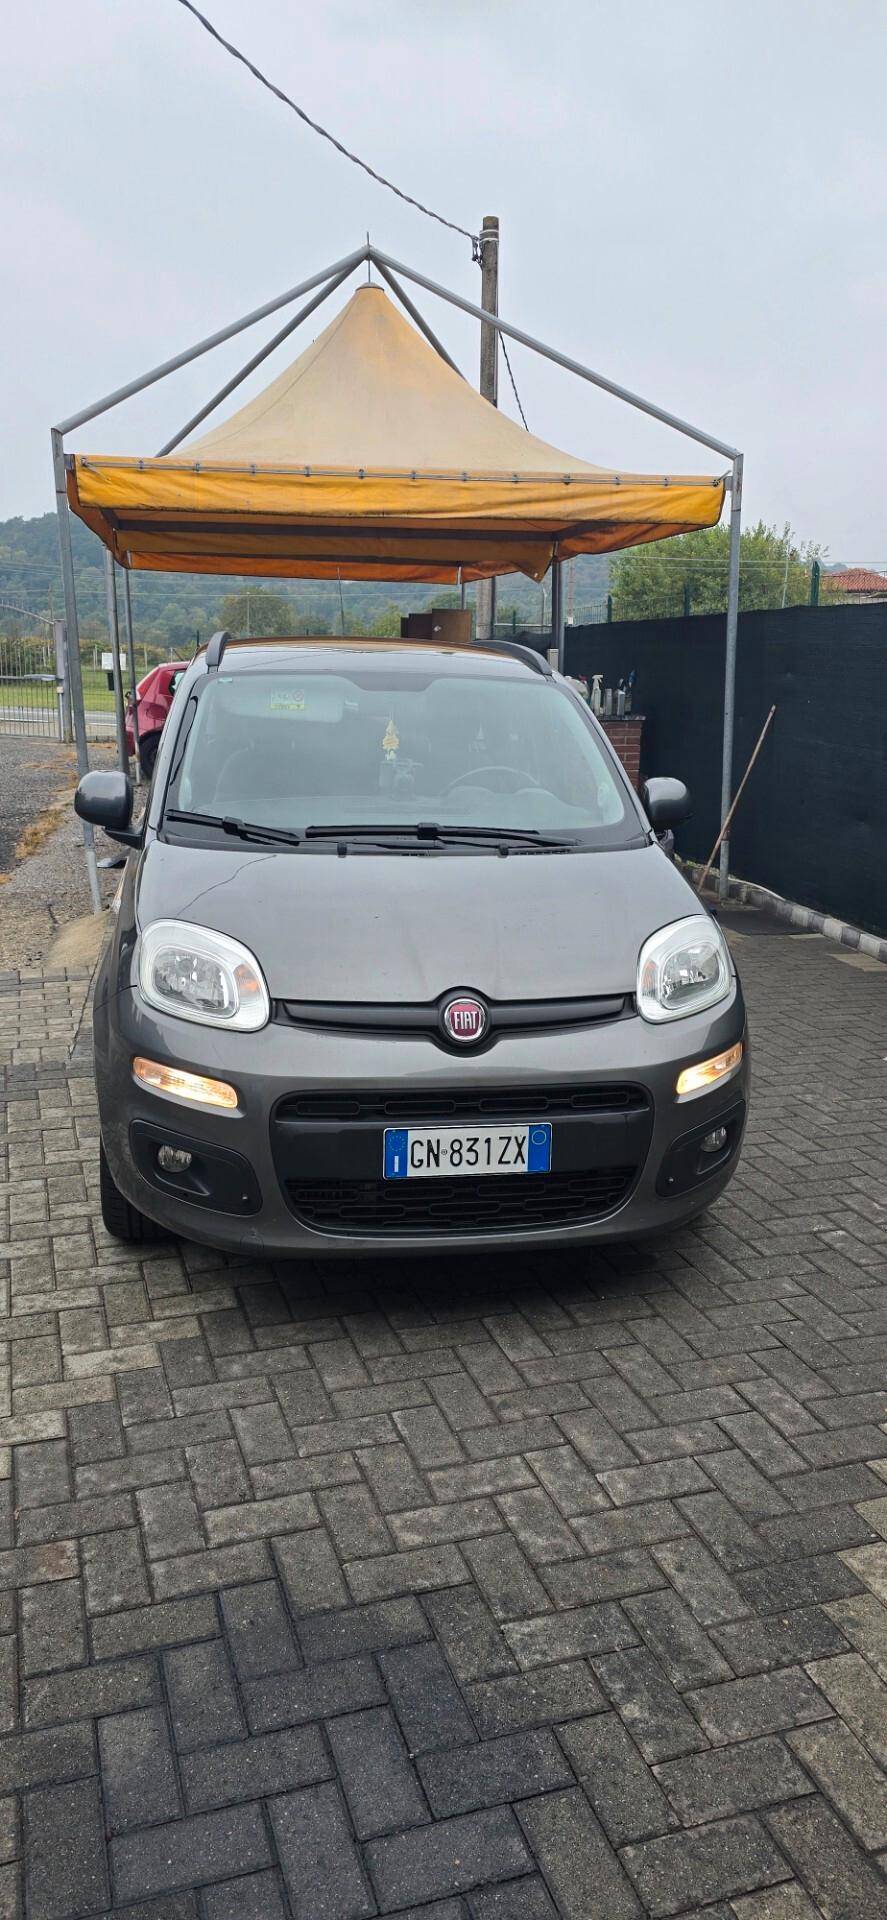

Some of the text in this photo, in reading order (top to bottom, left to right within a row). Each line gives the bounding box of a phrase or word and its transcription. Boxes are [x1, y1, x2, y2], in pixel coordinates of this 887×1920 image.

[453, 1011, 477, 1030] FIAT
[410, 1135, 527, 1169] GN 831ZX
[394, 1155, 399, 1173] I
